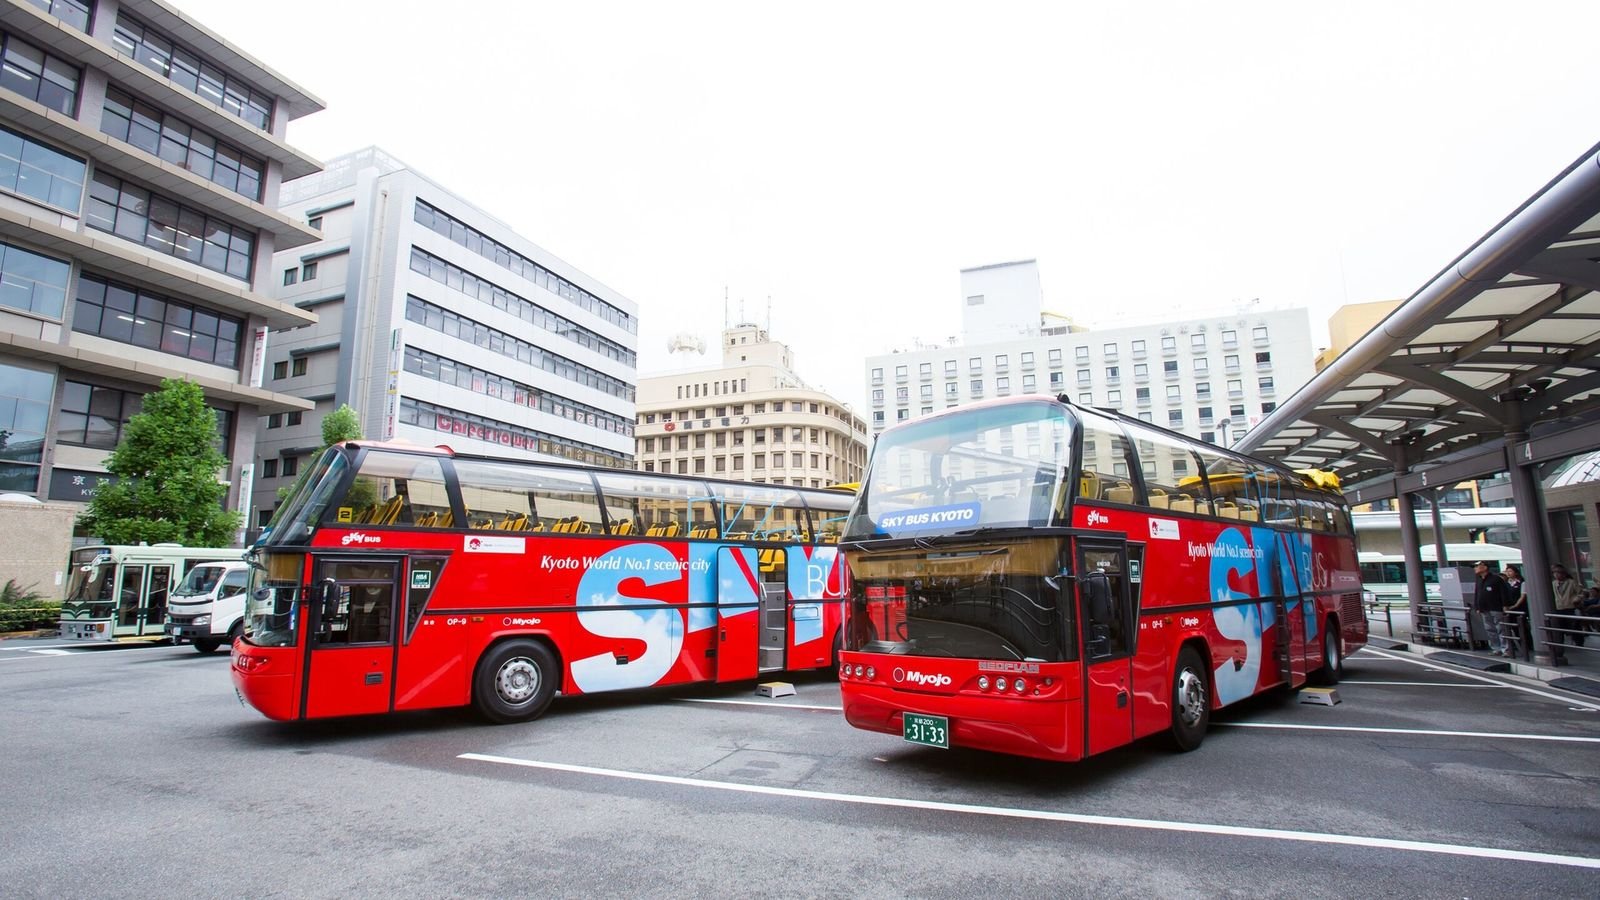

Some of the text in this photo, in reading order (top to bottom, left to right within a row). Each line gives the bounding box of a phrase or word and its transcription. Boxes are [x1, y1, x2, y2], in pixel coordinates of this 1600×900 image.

[1525, 443, 1532, 460] 4
[1422, 472, 1427, 486] 5
[340, 510, 351, 519] 2
[881, 508, 974, 528] SKY BUS KYOTO
[342, 532, 366, 546] SKY
[1187, 541, 1264, 562] Kyoto World No.1 scenic city
[540, 555, 712, 574] Kyoto World No.1 scenic city
[1302, 552, 1328, 588] BUS
[807, 565, 849, 597] BU
[512, 617, 541, 626] Myojo
[906, 671, 952, 687] Myojo
